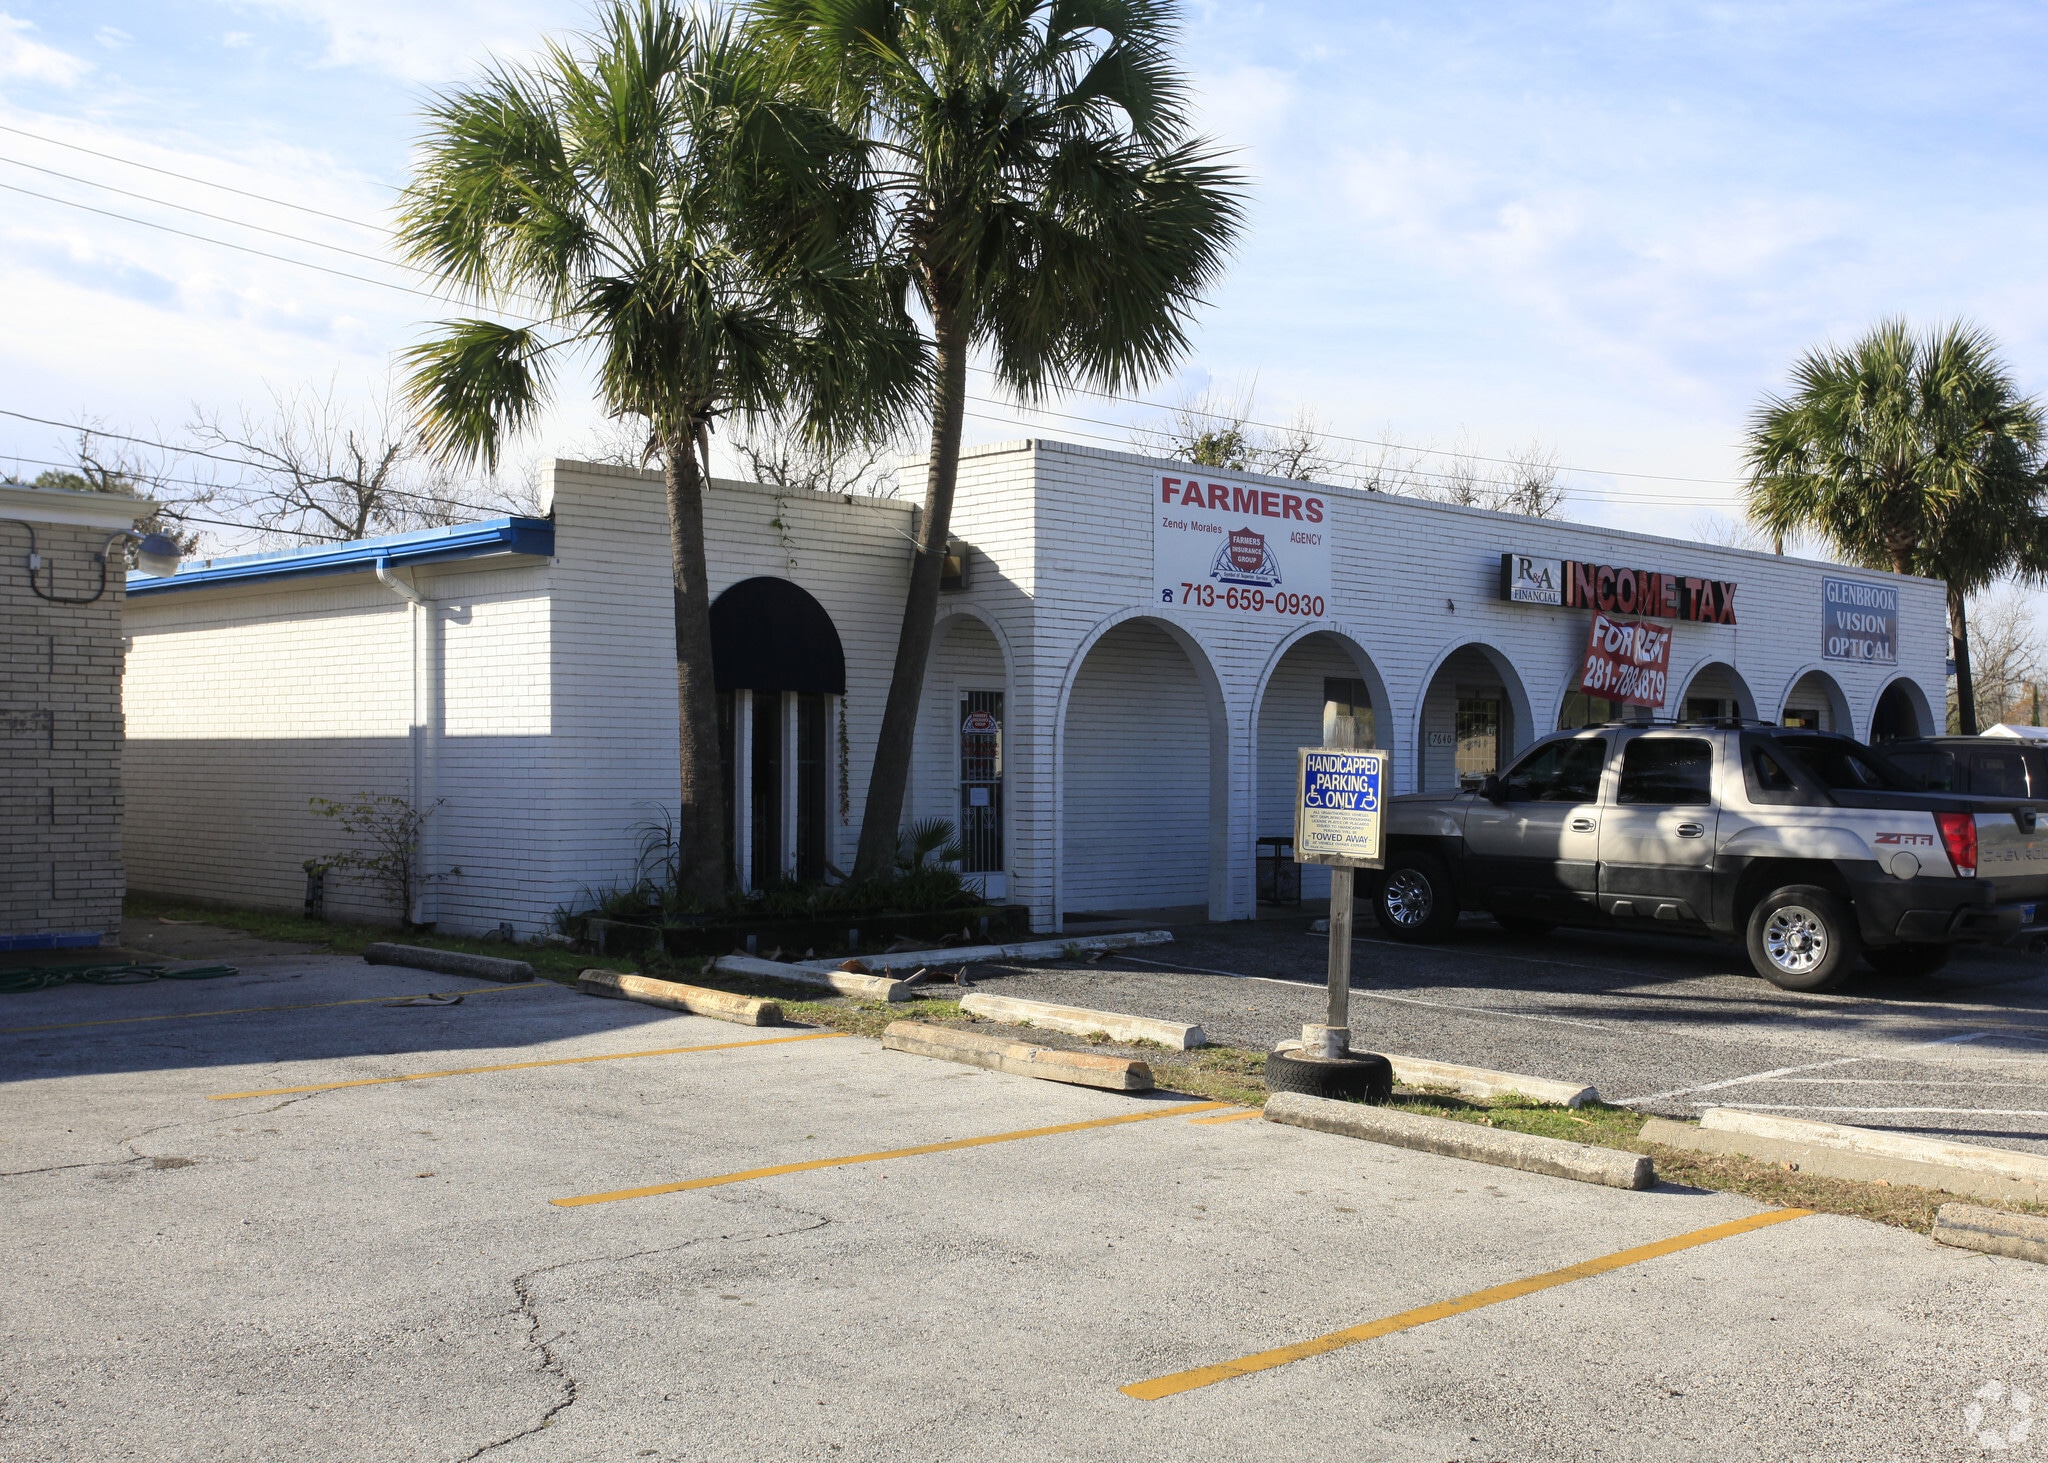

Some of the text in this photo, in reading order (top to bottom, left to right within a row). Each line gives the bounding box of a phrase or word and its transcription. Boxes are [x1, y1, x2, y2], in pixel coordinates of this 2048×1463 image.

[1161, 477, 1324, 524] FARMERS
[1162, 517, 1223, 534] Zendy Morales
[1232, 535, 1261, 546] FARMERS
[1290, 531, 1322, 546] AGENCY
[1231, 546, 1262, 555] INSURANCE
[1237, 555, 1257, 564] GROUP
[1518, 557, 1555, 590] R&A
[1181, 582, 1325, 617] 713-659-0930
[1514, 590, 1558, 604] FINANCIAL
[1566, 559, 1737, 625] INCOME TAX
[1826, 582, 1896, 611] GLENBROOK
[1836, 610, 1887, 635] VISION
[1591, 614, 1633, 657] FOR
[1828, 636, 1893, 660] OPTICAL
[1432, 733, 1452, 744] 7640
[1307, 755, 1378, 776] HANDICAPPED
[1316, 773, 1368, 793] PARKING
[1325, 791, 1358, 809] ONLY
